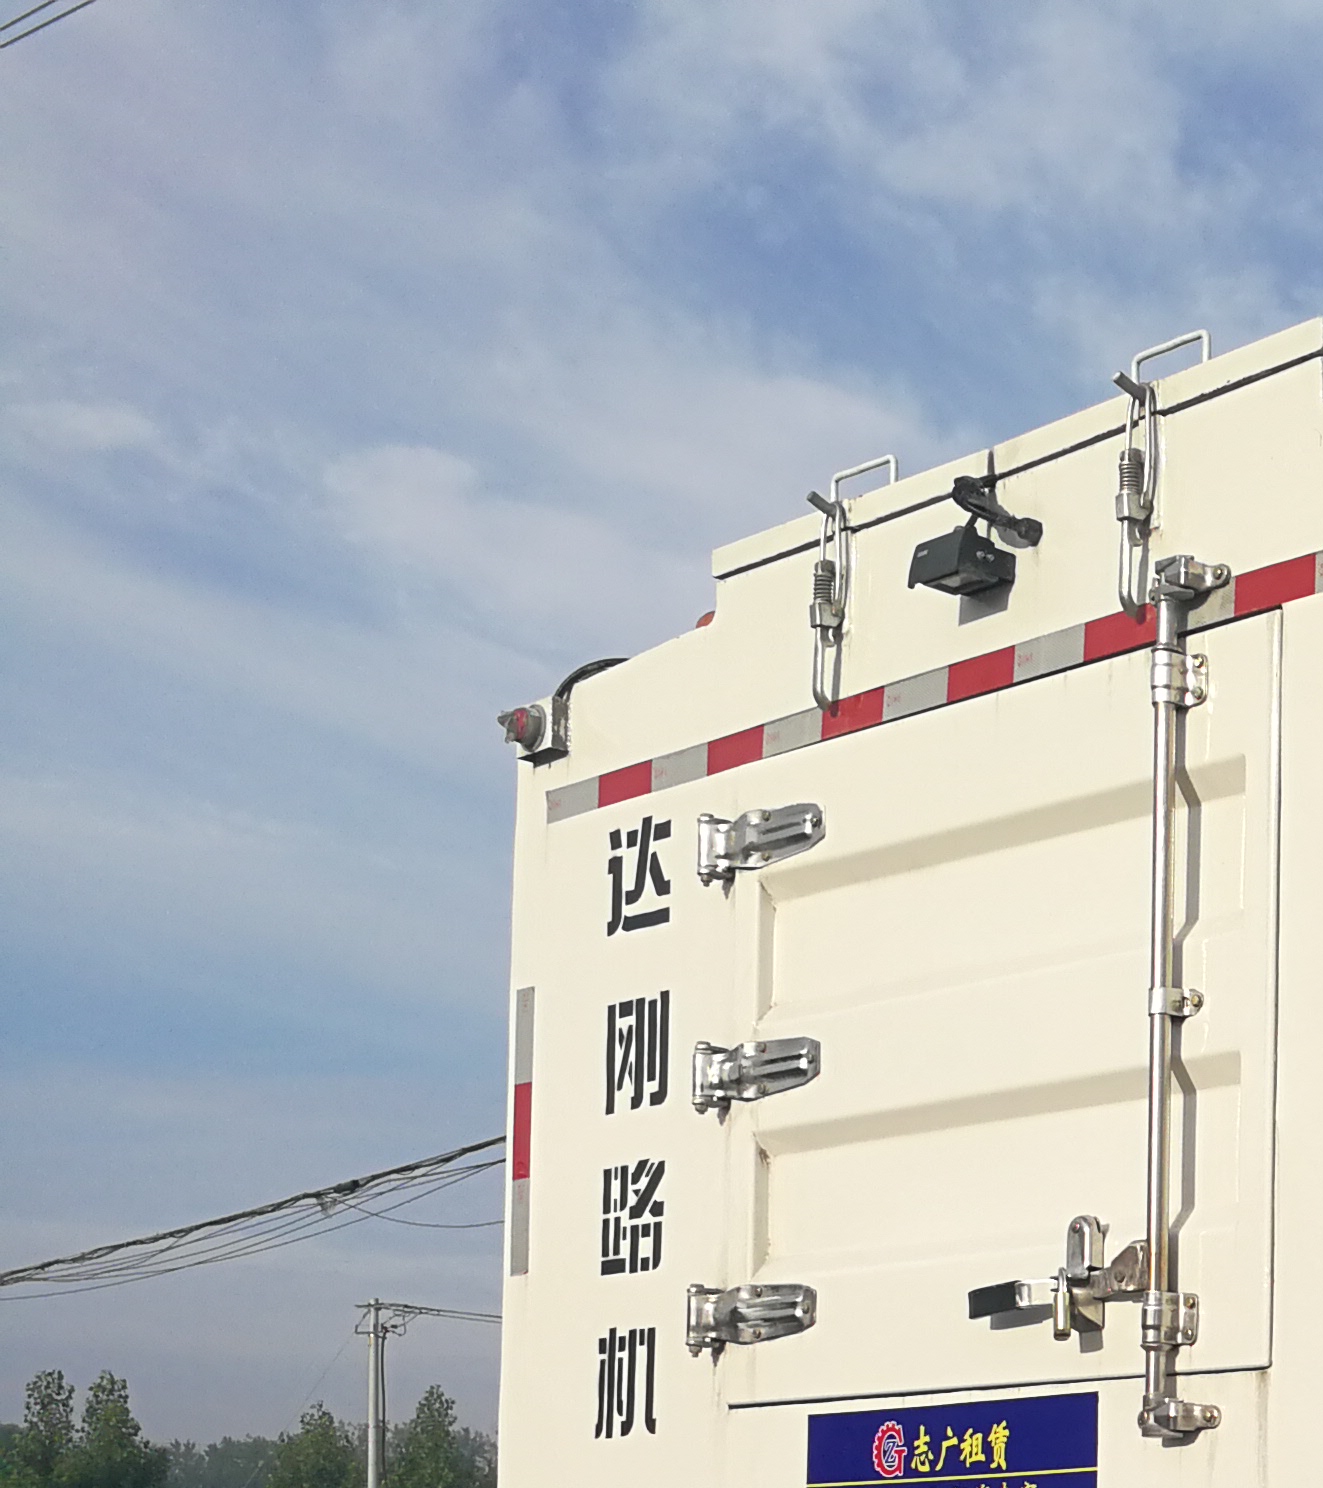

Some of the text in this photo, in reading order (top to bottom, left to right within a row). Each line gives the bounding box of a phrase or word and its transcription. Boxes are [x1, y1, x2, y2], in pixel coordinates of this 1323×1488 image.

[594, 815, 672, 1439] 达刚路机
[910, 1419, 1011, 1473] 志广租赁
